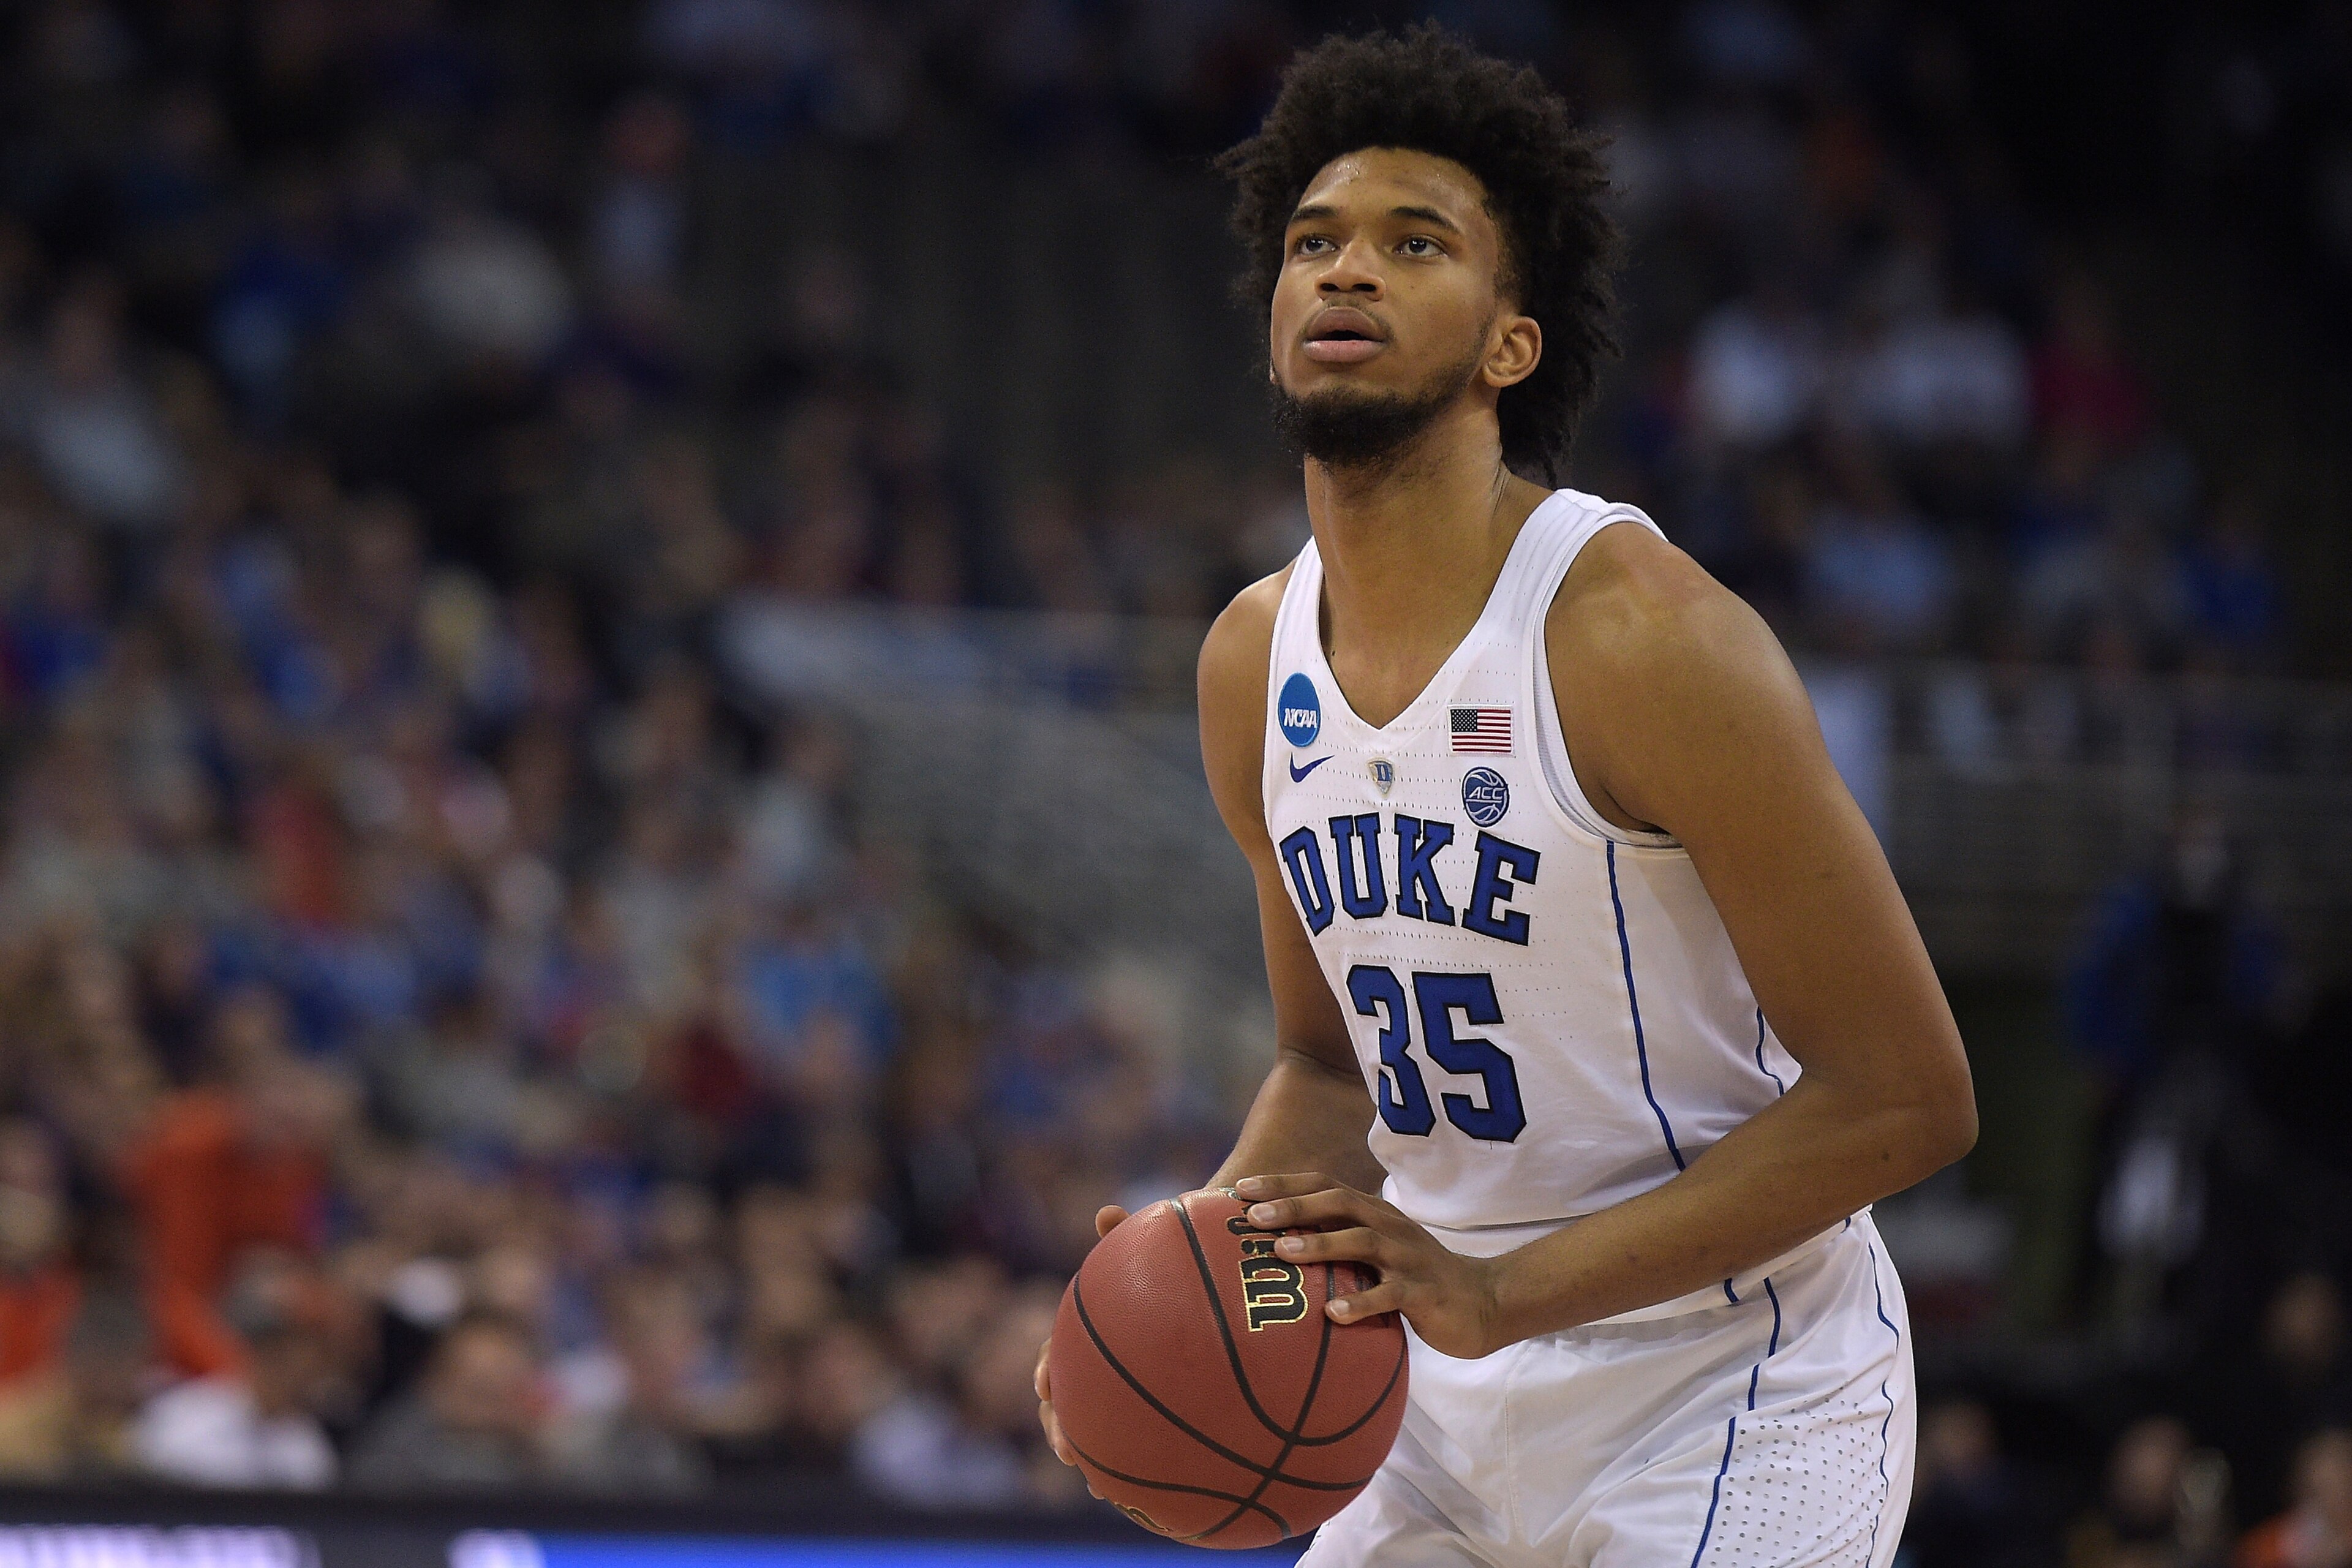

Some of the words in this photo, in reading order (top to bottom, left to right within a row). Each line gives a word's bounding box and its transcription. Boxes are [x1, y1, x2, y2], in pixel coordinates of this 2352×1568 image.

[1284, 708, 1317, 728] NCAA
[1469, 786, 1506, 799] ACC
[1279, 812, 1541, 946] DUKE
[1346, 964, 1527, 1143] 35
[1226, 1205, 1308, 1332] Wil
